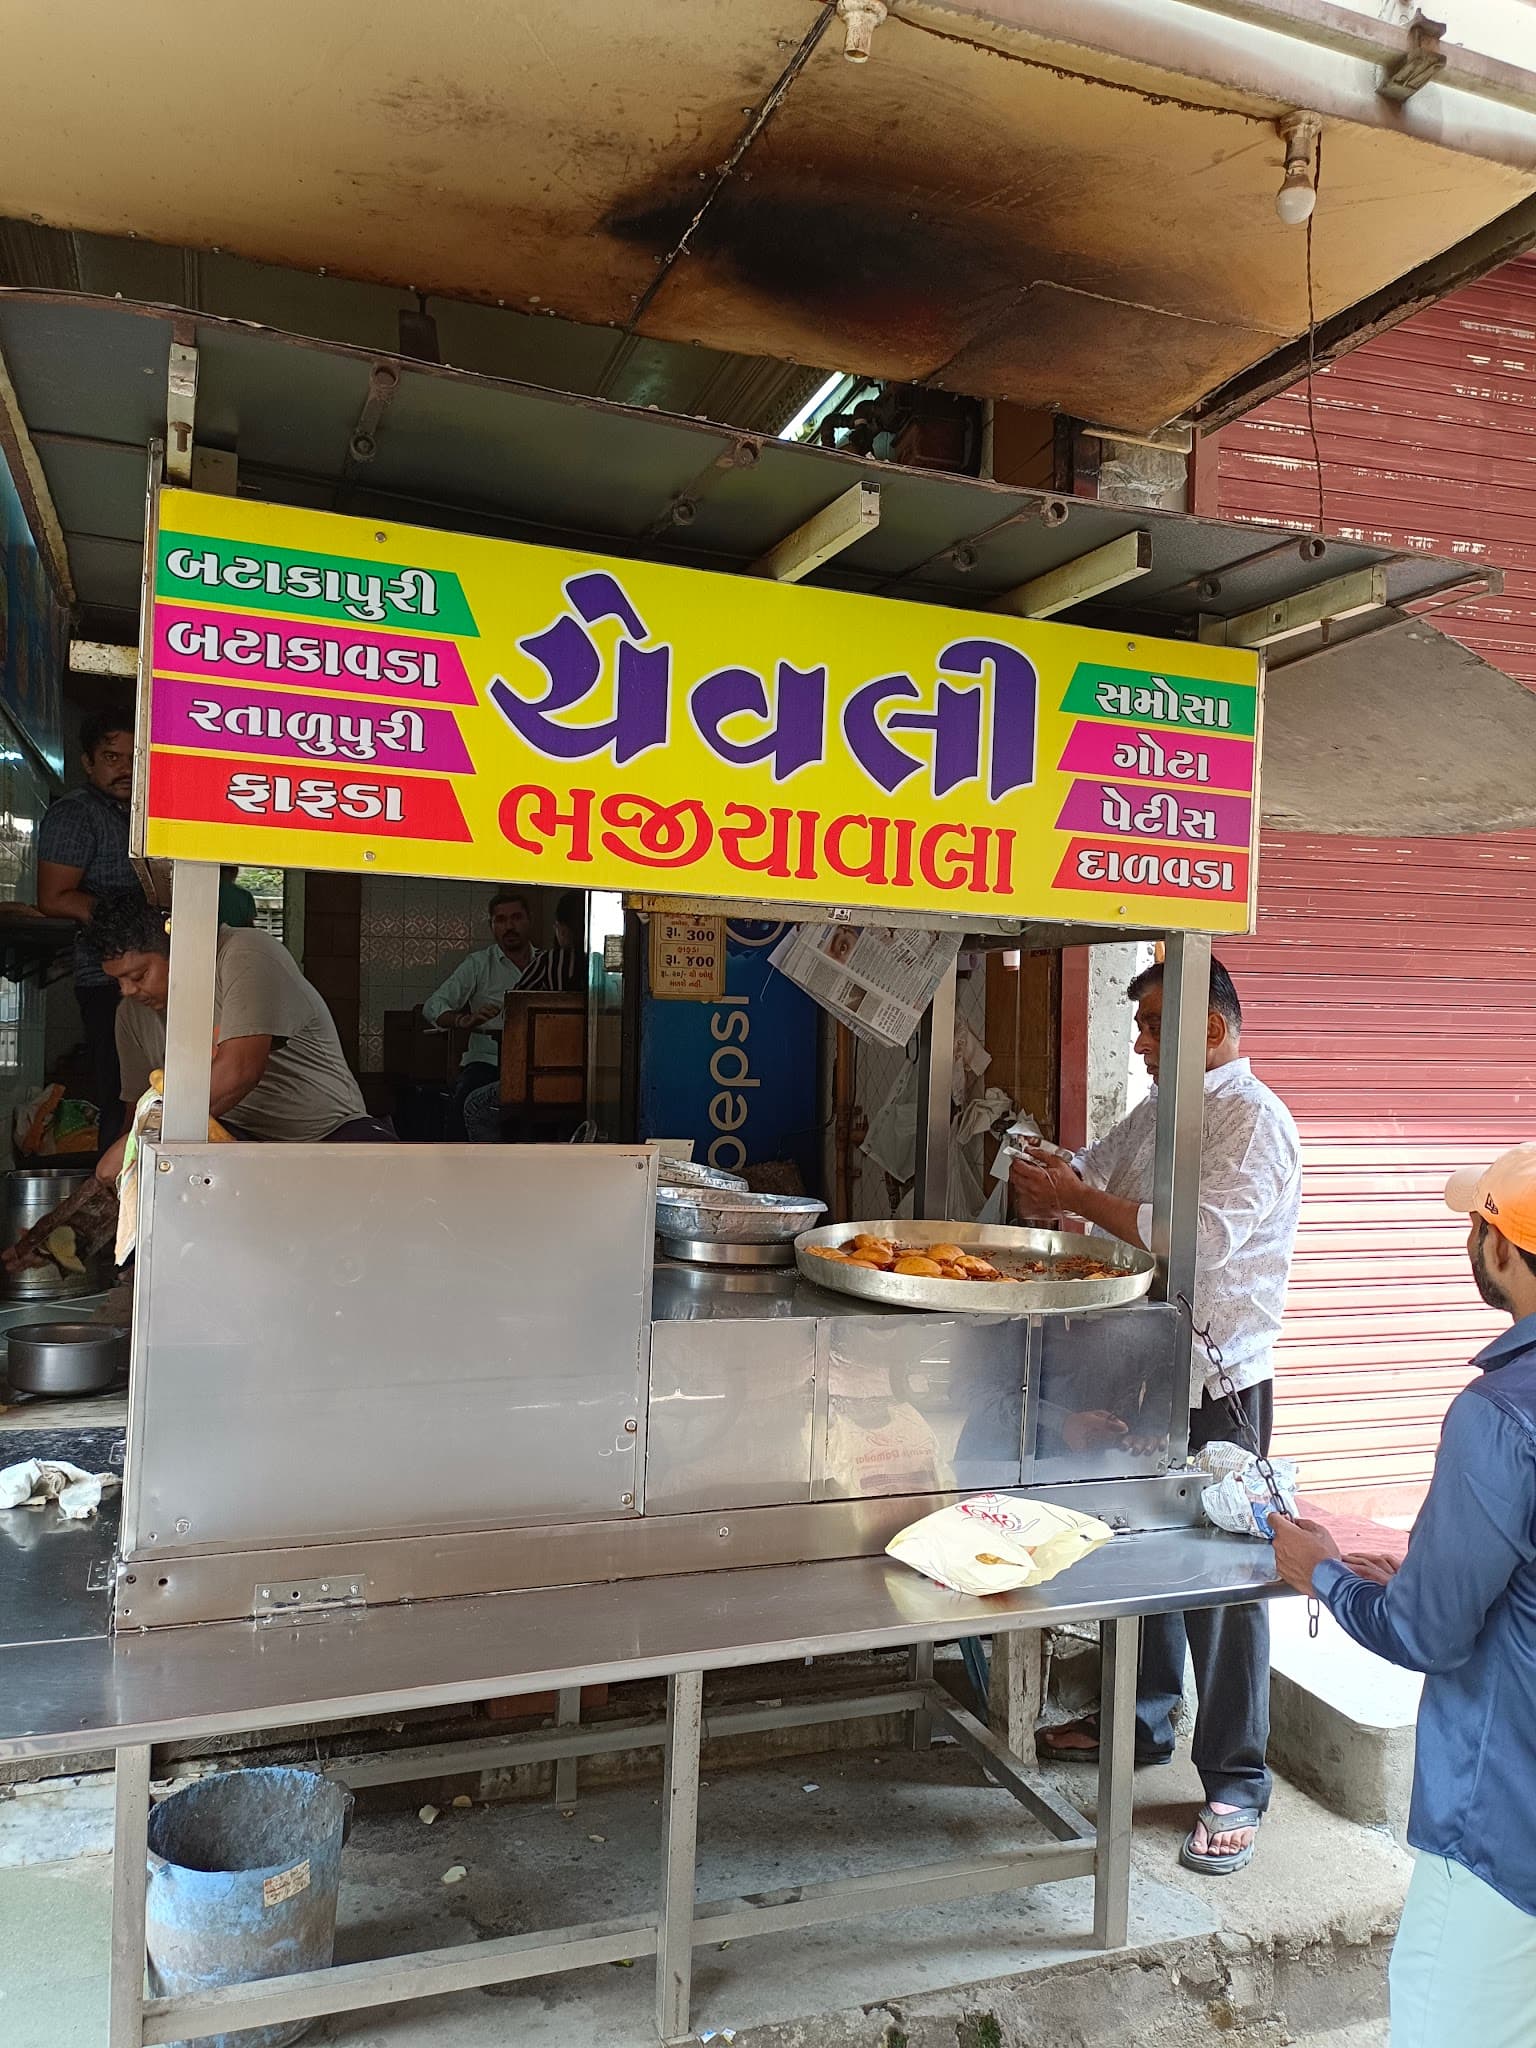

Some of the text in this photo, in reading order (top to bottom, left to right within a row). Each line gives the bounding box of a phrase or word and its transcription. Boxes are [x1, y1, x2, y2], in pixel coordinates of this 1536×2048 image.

[166, 548, 440, 622] બટાકાપુરી
[166, 621, 441, 688] બટાકાવડા
[489, 571, 1037, 801] ચેવલી
[1095, 676, 1232, 729] સમોસા
[188, 699, 427, 761] રતાળુપુરી
[1113, 732, 1211, 782] ગોટા
[226, 771, 407, 822] ફાફડા
[1100, 786, 1218, 840] પેટીસ
[498, 784, 1018, 895] ભજીયાવાલા
[1076, 849, 1236, 892] દાળવડા
